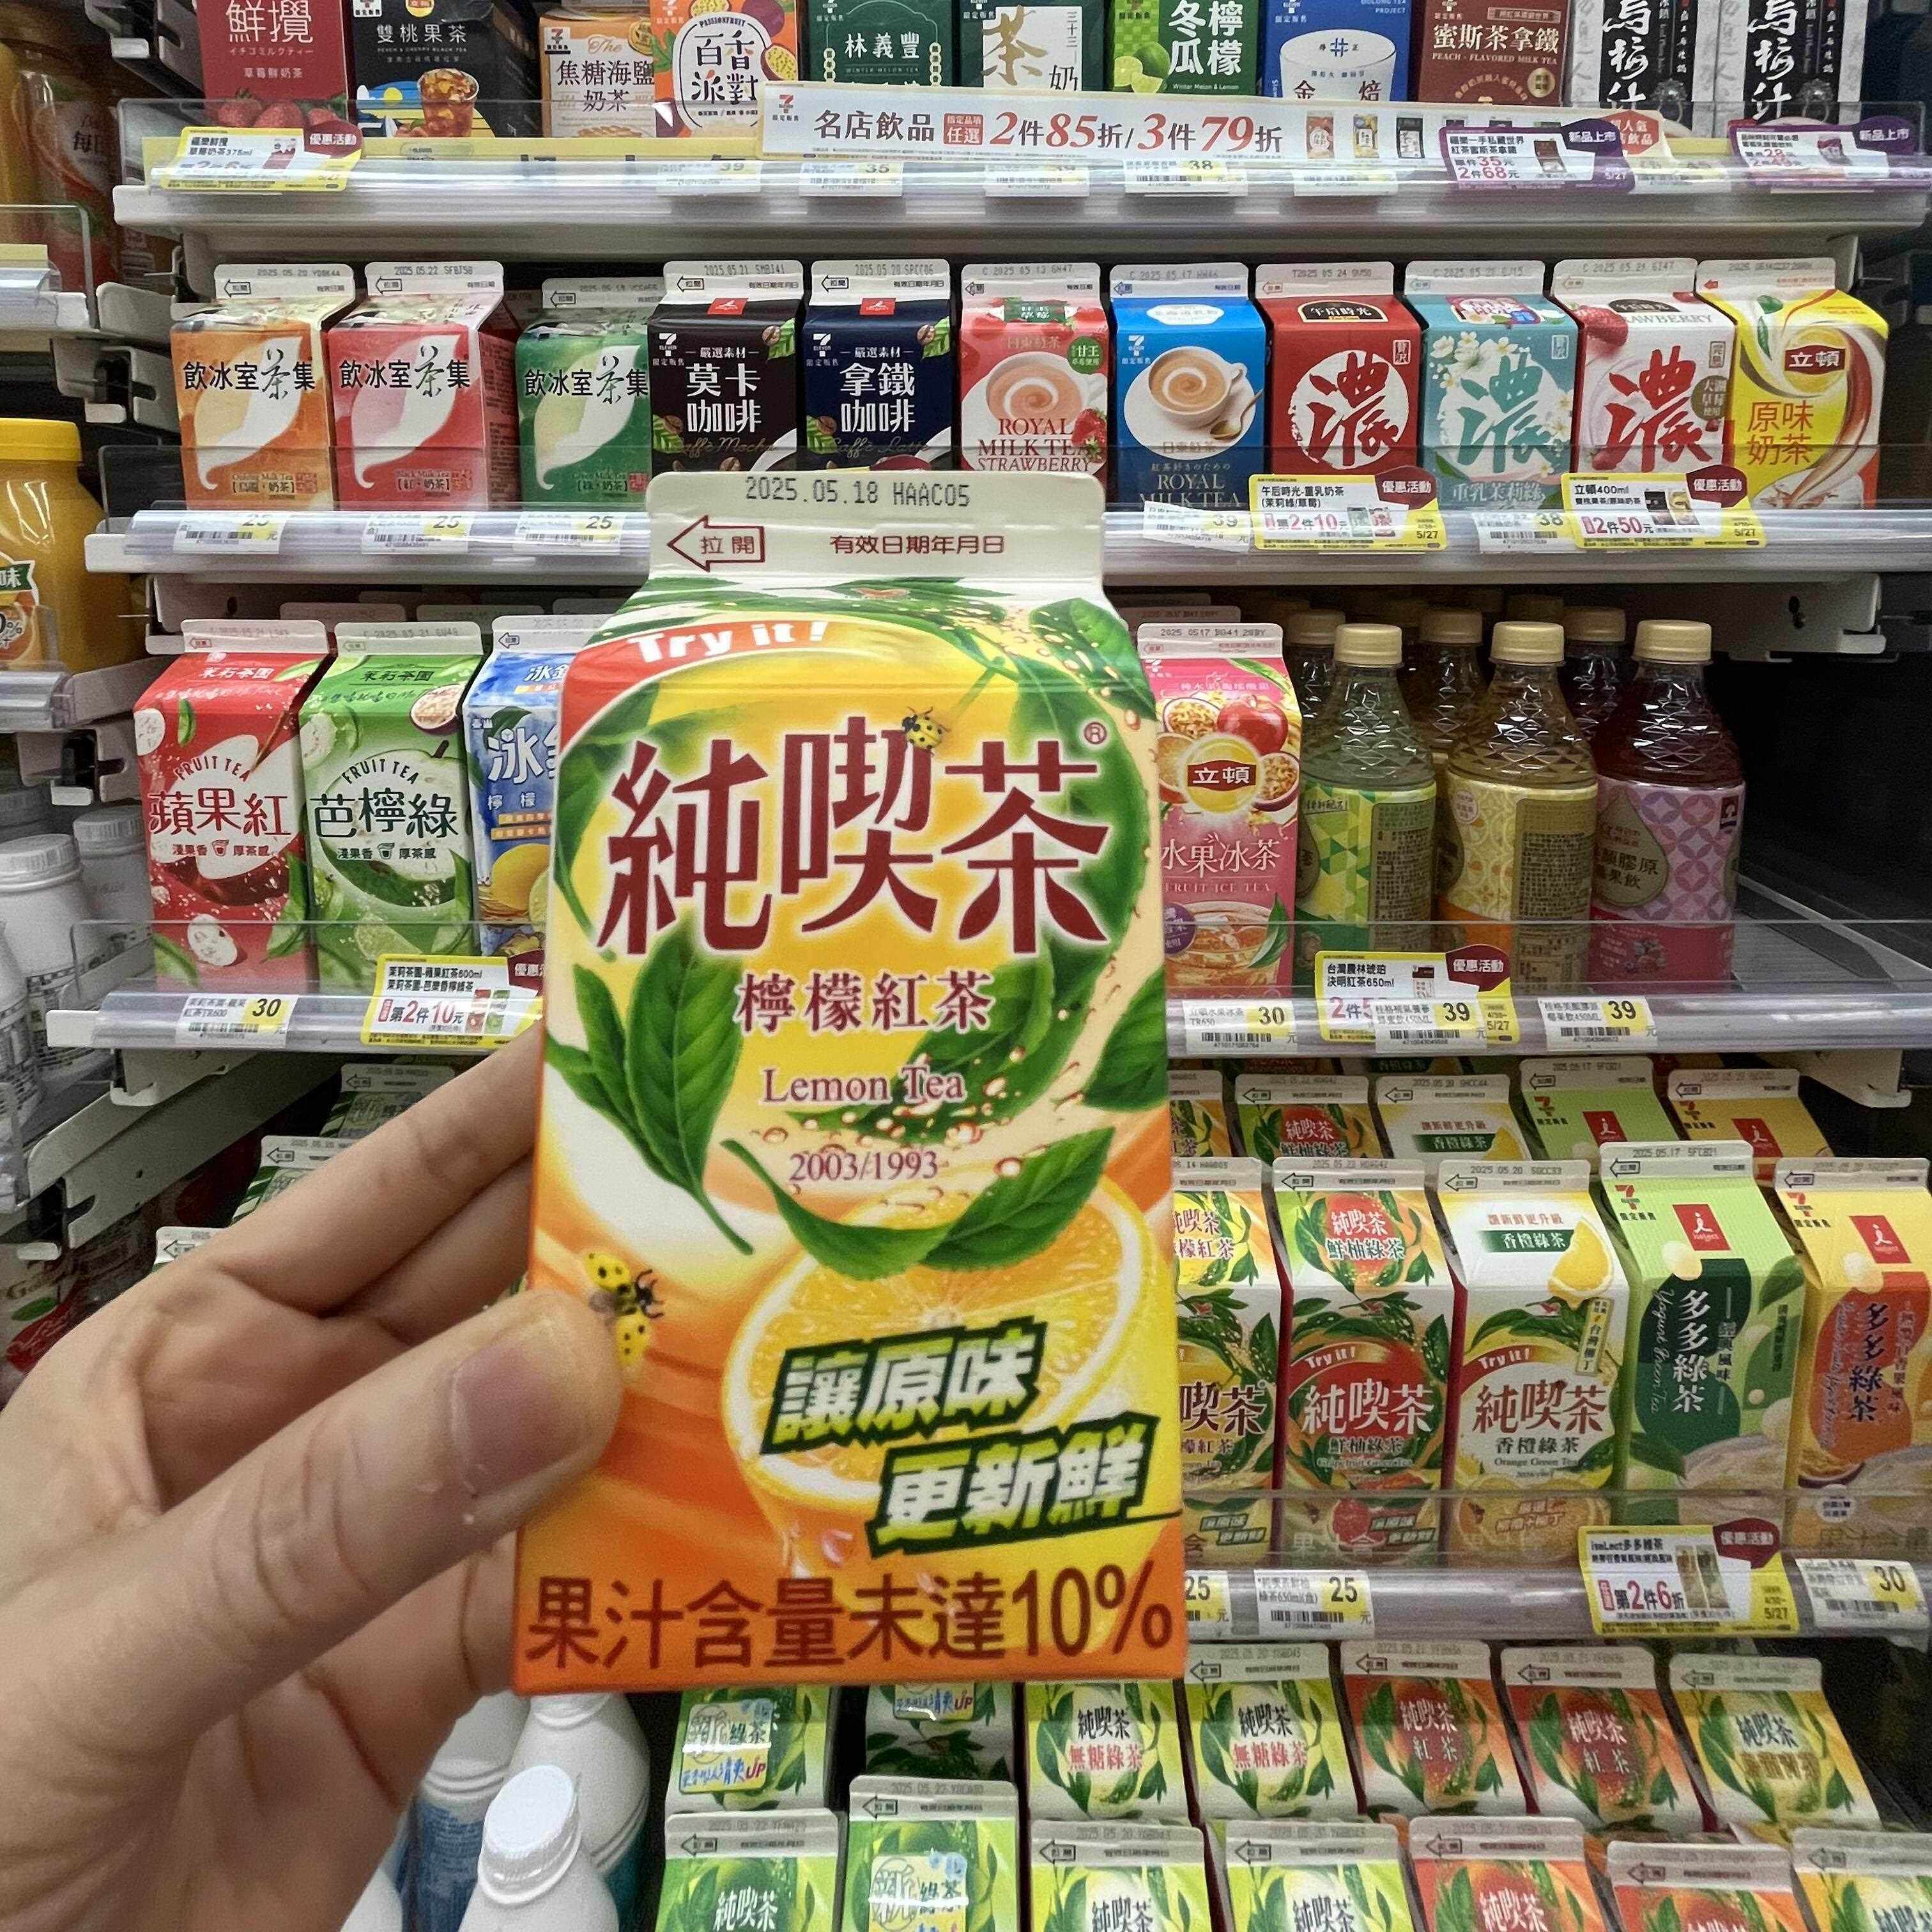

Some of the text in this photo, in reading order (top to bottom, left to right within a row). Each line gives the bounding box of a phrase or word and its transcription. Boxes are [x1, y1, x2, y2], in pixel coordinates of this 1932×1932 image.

[377, 24, 467, 43] 雙桃果茶
[845, 31, 920, 60] 林義豐
[1432, 24, 1560, 54] 蜜斯茶拿鐵
[1432, 52, 1461, 61] PEACH
[583, 89, 629, 112] 奶茶
[813, 109, 935, 142] 名店飲品
[947, 127, 983, 144] 任選
[182, 347, 316, 400] 飲冰室茶集
[339, 344, 471, 397] 飲冰室茶集
[1788, 351, 1841, 368] 立頓
[525, 355, 649, 404] 飲冰室茶集
[686, 363, 761, 397] 莫卡
[839, 362, 916, 397] 拿鐵
[687, 399, 762, 433] 咖啡
[840, 399, 916, 433] 咖啡
[997, 417, 1074, 436] ROYAL
[1747, 400, 1814, 433] 原味
[977, 438, 1044, 456] MILK
[1746, 434, 1813, 466] 奶茶
[977, 457, 1092, 473] STRAWBERRY
[745, 476, 879, 505] 2025.05.18
[1157, 475, 1226, 490] ROYAL
[585, 515, 614, 530] 25
[700, 536, 756, 555] 拉開
[830, 535, 1005, 555] 有效日期年月日
[636, 625, 732, 664] Try
[173, 755, 252, 783] FRUIT TEA
[341, 758, 420, 786] FRUIT TEA
[1192, 766, 1250, 786] 立頓
[148, 786, 292, 837] 蘋果紅
[309, 786, 459, 839] 芭檸綠
[596, 715, 1111, 956] 純喫茶
[1160, 838, 1281, 878] 水果冰茶
[515, 963, 544, 977] 優惠
[252, 998, 282, 1017] 30
[739, 970, 993, 1033] 檸檬紅茶
[1258, 1006, 1285, 1025] 30
[1442, 1002, 1471, 1022] 39
[1607, 1000, 1636, 1020] 39
[763, 1066, 965, 1102] Lemon Tea
[790, 1151, 940, 1181] 2003/1993
[1331, 1209, 1390, 1236] 純喫茶
[1175, 1238, 1235, 1259] 檬紅茶
[1671, 1288, 1712, 1413] 多多綠茶
[770, 1325, 1041, 1446] 讓原味
[1179, 1380, 1268, 1437] 喫茶
[1301, 1377, 1435, 1436] 純喫茶
[1471, 1378, 1607, 1434] 純喫茶
[1496, 1437, 1581, 1455] 香橙綠茶
[875, 1422, 1148, 1542] 更新鮮
[1185, 1575, 1211, 1601] 25
[1328, 1575, 1358, 1603] 25
[1873, 1565, 1906, 1593] 30
[525, 1561, 1174, 1670] 果汁含量未達10%
[1077, 1706, 1131, 1740] 純喫茶
[1237, 1702, 1293, 1738] 純喫茶
